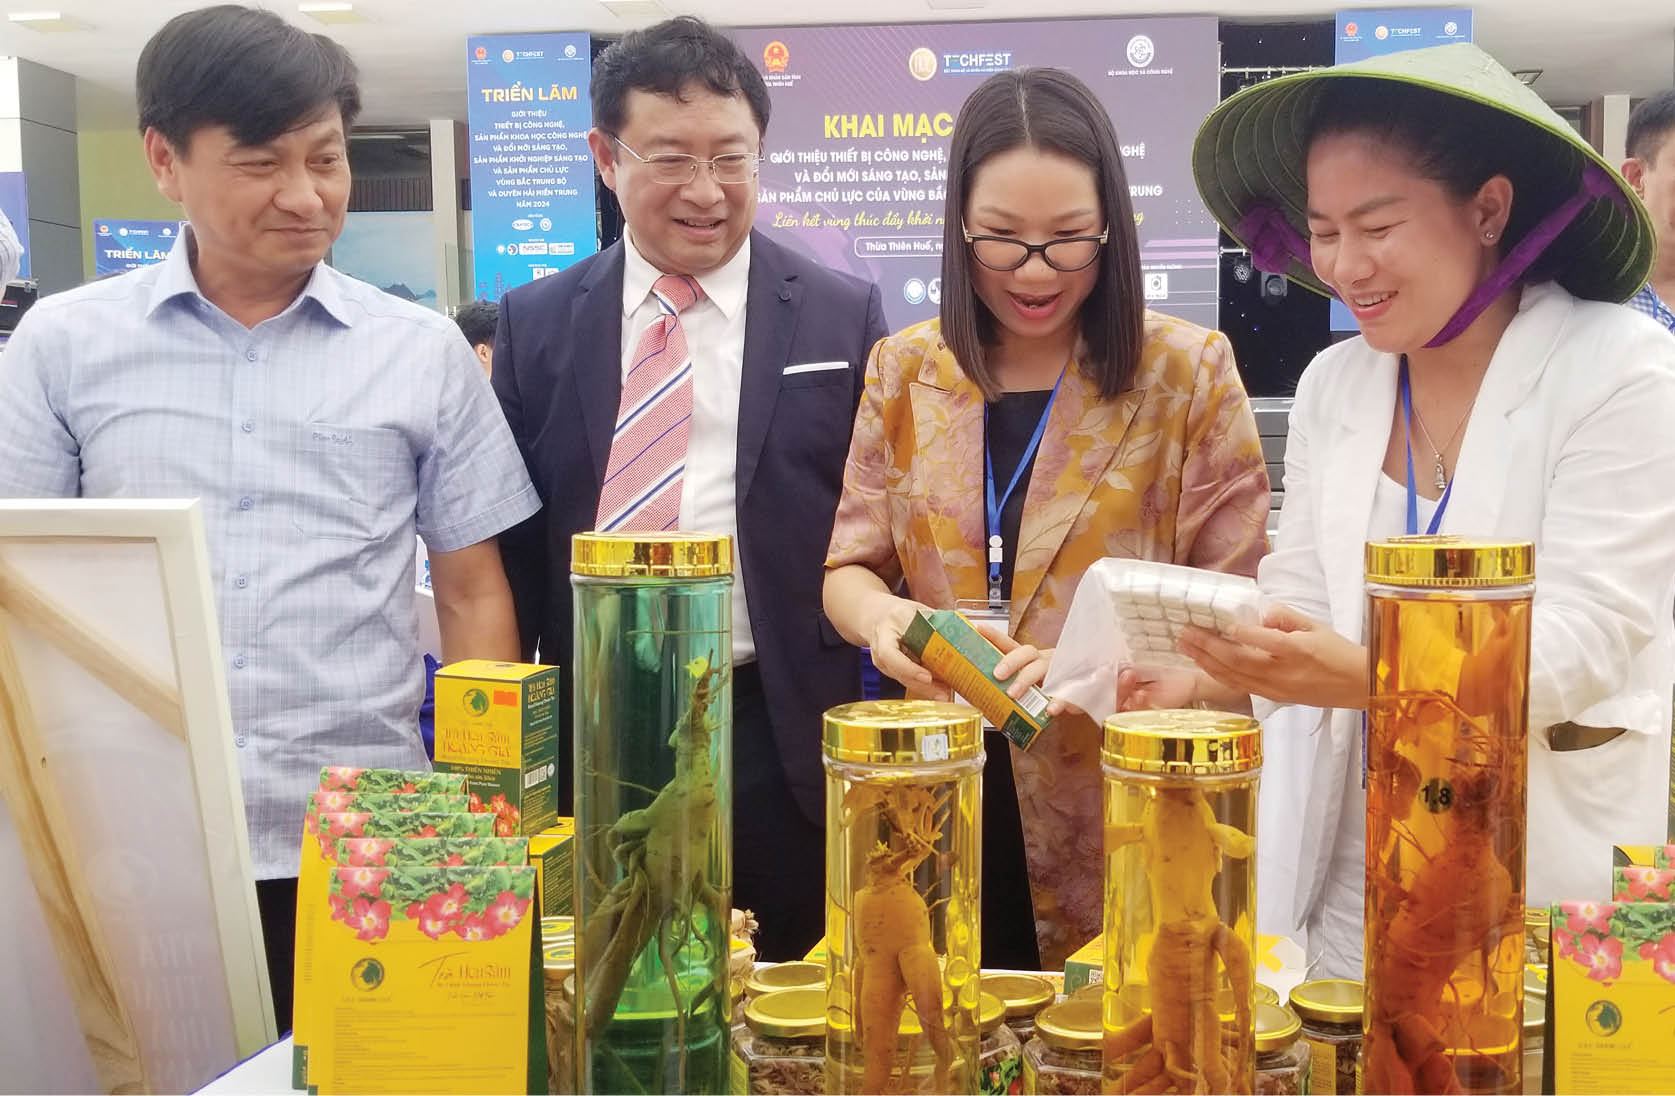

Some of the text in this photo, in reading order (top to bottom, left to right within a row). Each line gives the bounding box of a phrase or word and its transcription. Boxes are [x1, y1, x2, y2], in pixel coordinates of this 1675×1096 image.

[944, 53, 1012, 67] TECHFEST
[481, 80, 577, 102] TRIỂN LÃM
[824, 112, 953, 144] KHAI MẠC
[770, 142, 1145, 165] GIỚI THIỆU THIẾT BỊ CÔNG NGHỆ, GHỆ
[794, 166, 947, 184] VÀ ĐỔI MỚI SÁNG TẠO, SẢN
[780, 185, 812, 203] PHẨM
[815, 187, 839, 202] CHỦ
[842, 189, 863, 204] LỰC
[866, 187, 890, 202] CỦA
[893, 187, 925, 201] VÙNG
[1129, 185, 1163, 197] RUNG
[772, 210, 800, 228] Liên
[803, 211, 821, 227] kết
[823, 214, 851, 230] vùng
[854, 210, 879, 227] thúc
[882, 210, 904, 230] đẩy
[907, 209, 932, 226] khởi
[104, 246, 142, 259] TRIỂN
[866, 241, 886, 251] Thừa
[888, 240, 912, 251] Thiên
[913, 240, 934, 252] Huế,
